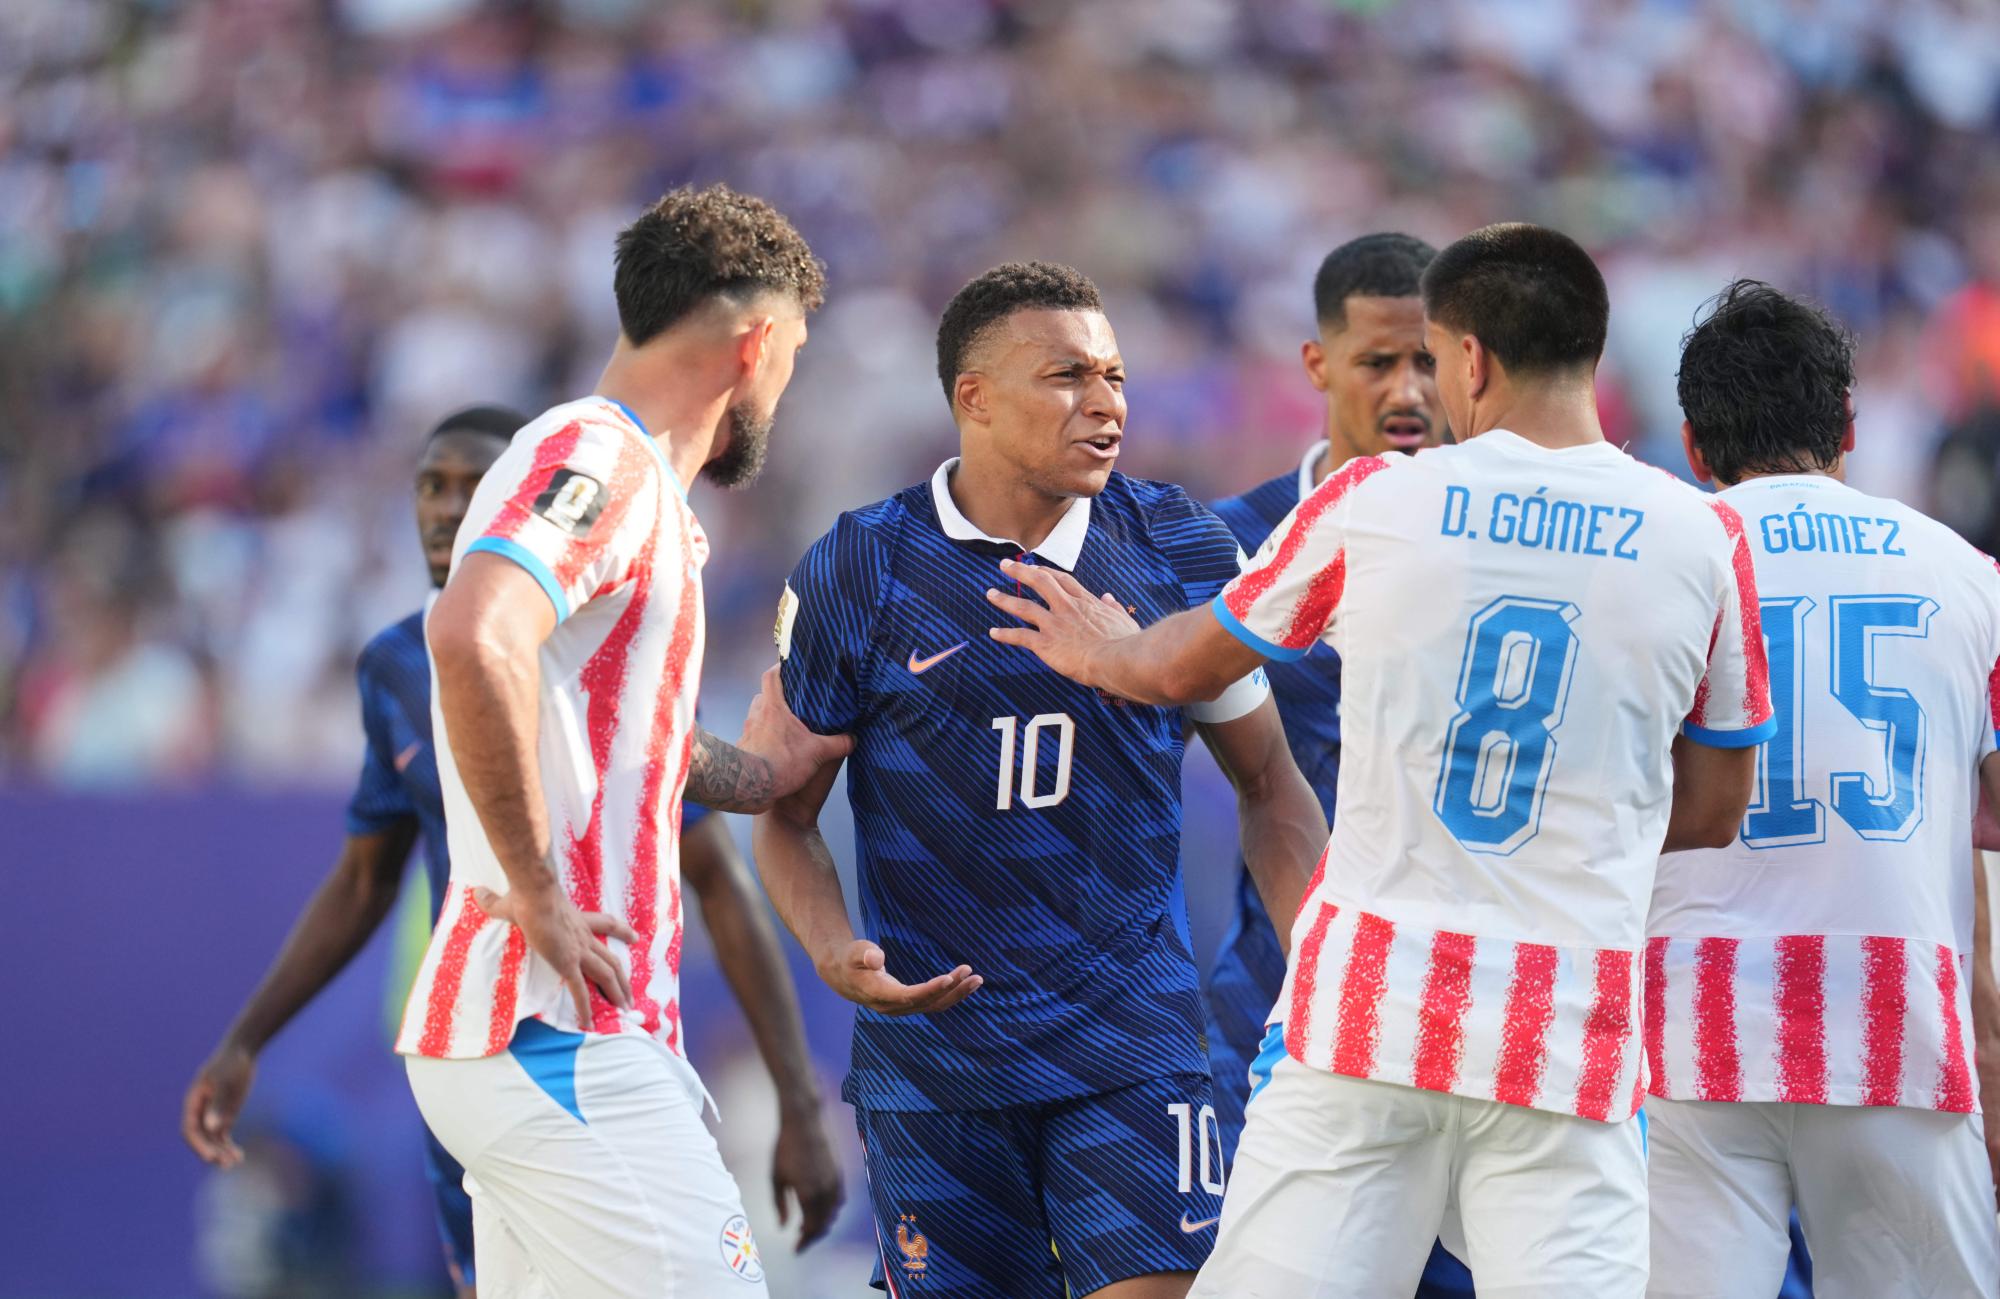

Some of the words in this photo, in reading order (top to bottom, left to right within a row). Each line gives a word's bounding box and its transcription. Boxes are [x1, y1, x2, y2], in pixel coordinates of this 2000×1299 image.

[1440, 485, 1477, 540] D.
[1488, 485, 1645, 561] GÓMEZ
[1759, 502, 1906, 557] GÓMEZ
[991, 712, 1076, 811] 10
[1432, 594, 1582, 857] 8
[1738, 593, 1941, 851] 15
[1167, 1102, 1226, 1197] 10
